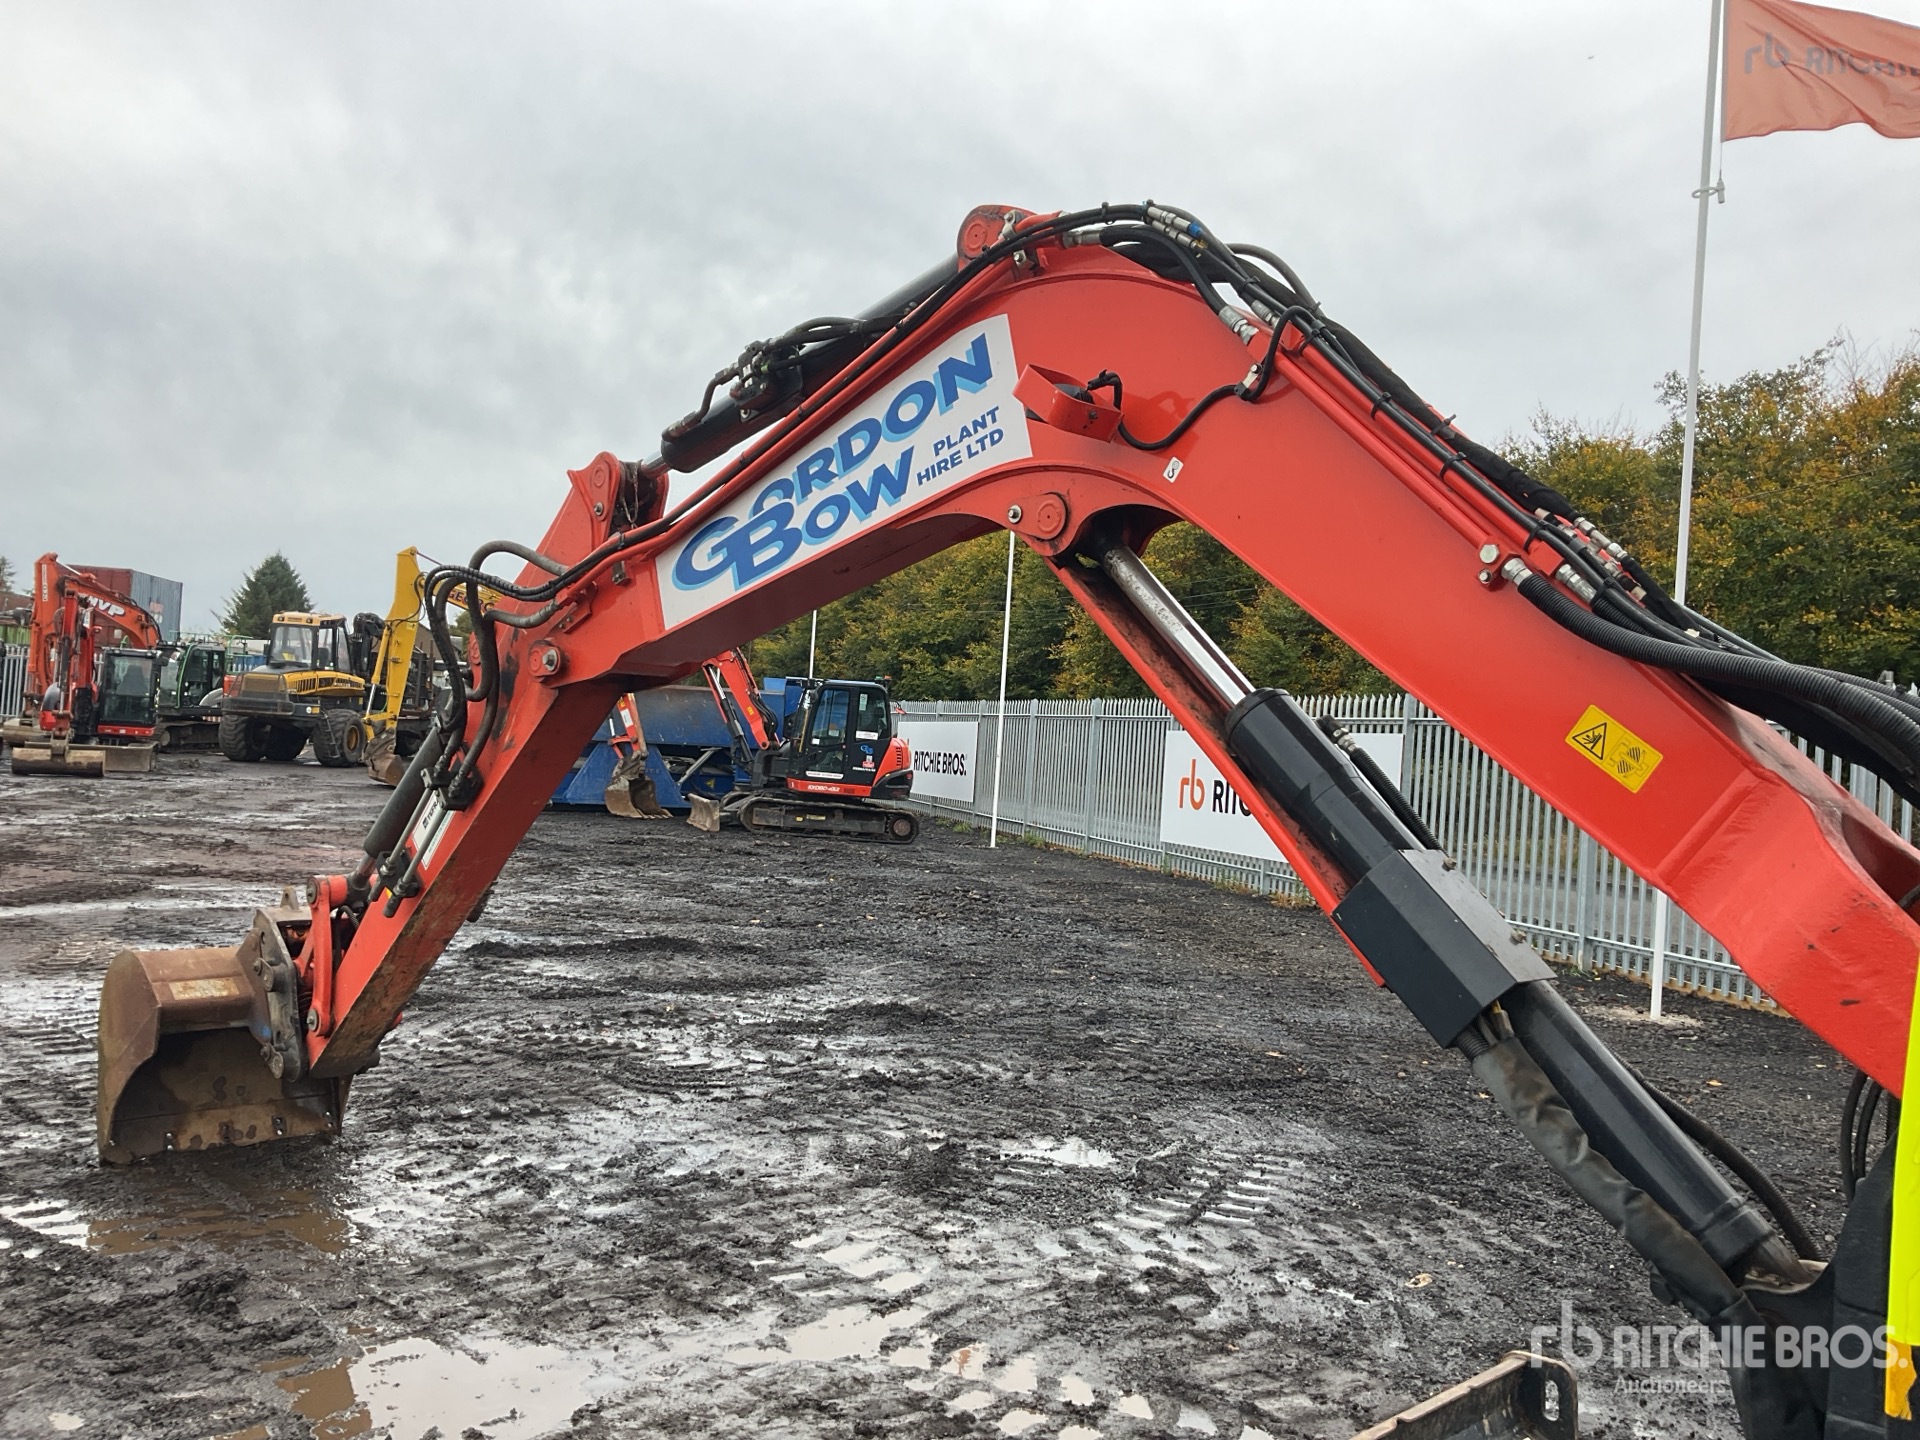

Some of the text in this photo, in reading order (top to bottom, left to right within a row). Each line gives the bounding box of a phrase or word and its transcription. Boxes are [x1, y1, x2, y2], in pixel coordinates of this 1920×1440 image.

[917, 428, 1004, 487] HIRE LTD
[933, 406, 1000, 457] PLANT
[734, 446, 915, 592] BOW
[913, 750, 967, 777] RITCHIE BROS.
